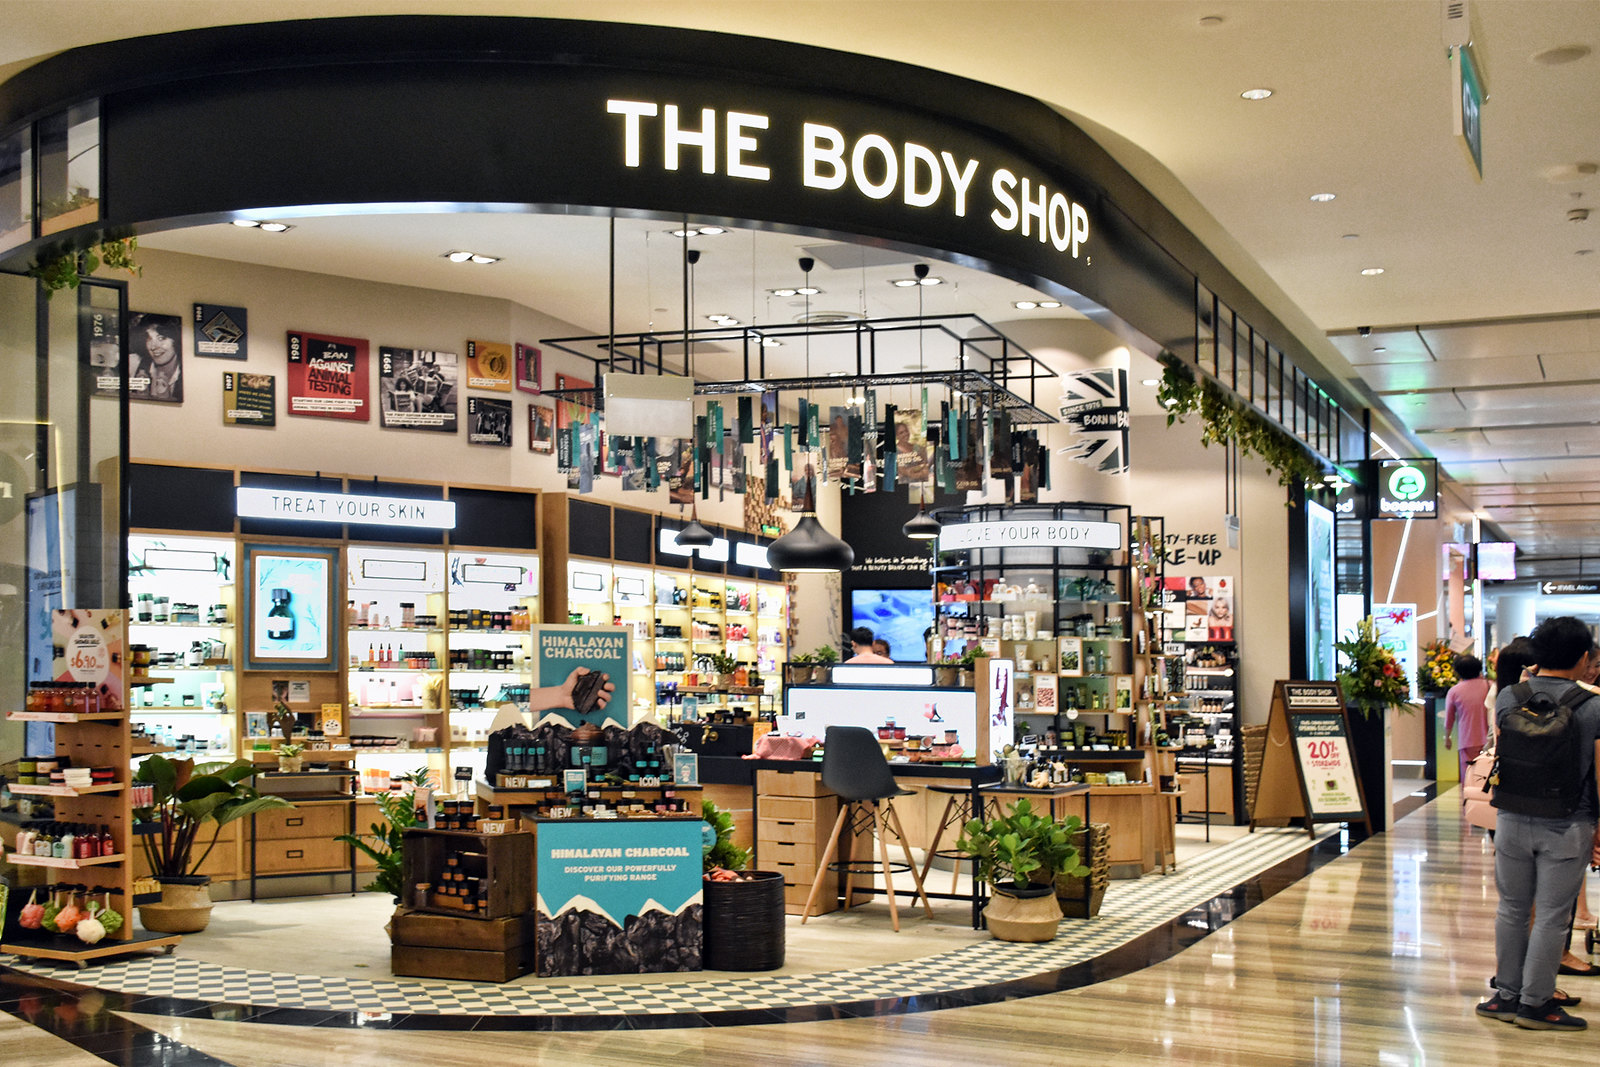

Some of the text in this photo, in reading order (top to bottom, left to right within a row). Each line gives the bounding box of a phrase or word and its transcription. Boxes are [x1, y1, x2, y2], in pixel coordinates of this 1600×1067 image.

[607, 99, 1089, 259] THE BODY SHOP
[93, 314, 104, 337] 1976
[291, 337, 300, 360] 1989
[309, 357, 353, 375] AGAINST
[383, 353, 392, 373] 1991
[308, 368, 352, 385] ANIMAL
[308, 379, 351, 397] TESTING
[1063, 404, 1085, 415] SINCE
[1083, 414, 1109, 426] BORN
[1109, 414, 1117, 425] IN
[272, 495, 426, 520] TREAT YOUR SKIN
[1000, 526, 1040, 541] YOUR
[1047, 526, 1090, 541] BODY
[542, 636, 624, 649] HIMALAYAN
[71, 650, 97, 669] $6.90
[545, 648, 621, 660] CHARCOAL
[1291, 688, 1333, 696] THE BODY SHOP
[1307, 740, 1339, 759] 20%
[504, 776, 526, 788] NEW
[639, 776, 661, 787] ICON
[550, 806, 572, 818] NEW
[482, 822, 505, 834] NEW
[551, 847, 690, 859] HIMALAYAN CHARCOAL
[564, 864, 677, 874] DISCOVER OUR POWERFULLY
[584, 873, 657, 882] PURIFYING RANGE
